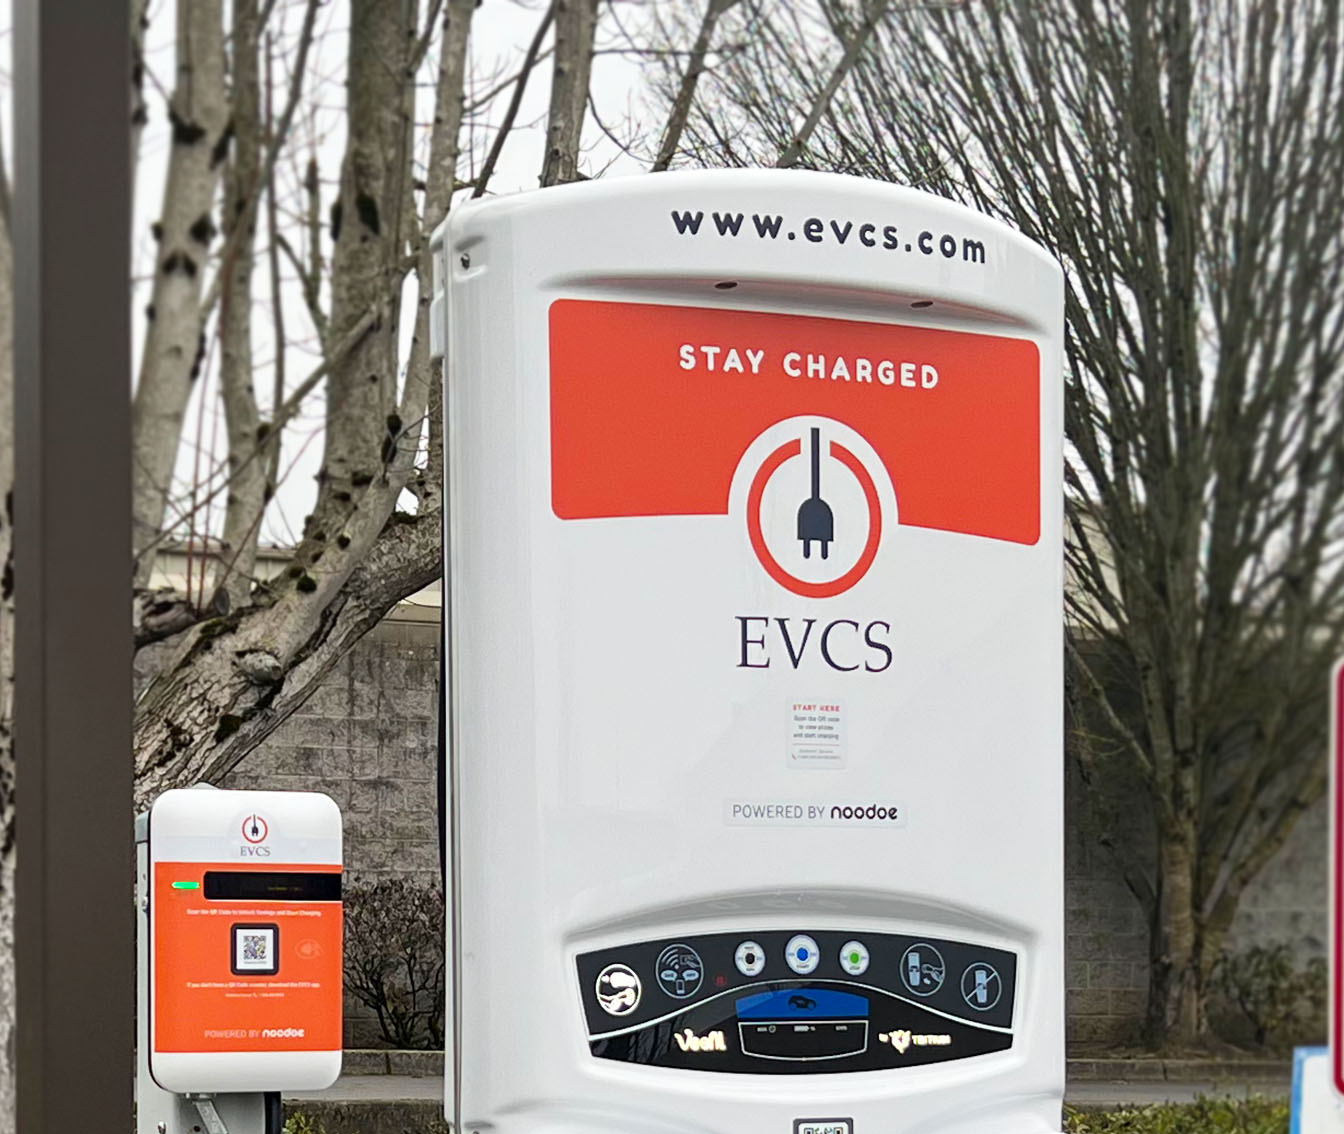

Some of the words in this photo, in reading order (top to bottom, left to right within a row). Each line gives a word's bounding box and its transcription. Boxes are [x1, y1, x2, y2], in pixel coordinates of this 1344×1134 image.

[672, 209, 987, 265] www.evcs.com
[679, 343, 764, 374] STAY
[784, 352, 940, 389] CHARGED
[735, 616, 893, 673] EVCS
[733, 803, 803, 819] POWERED
[808, 804, 825, 819] BY
[830, 803, 898, 820] noodoe
[240, 846, 271, 857] EVCS
[204, 1029, 247, 1039] POWERED
[249, 1030, 260, 1039] BY
[262, 1027, 305, 1038] noodoe
